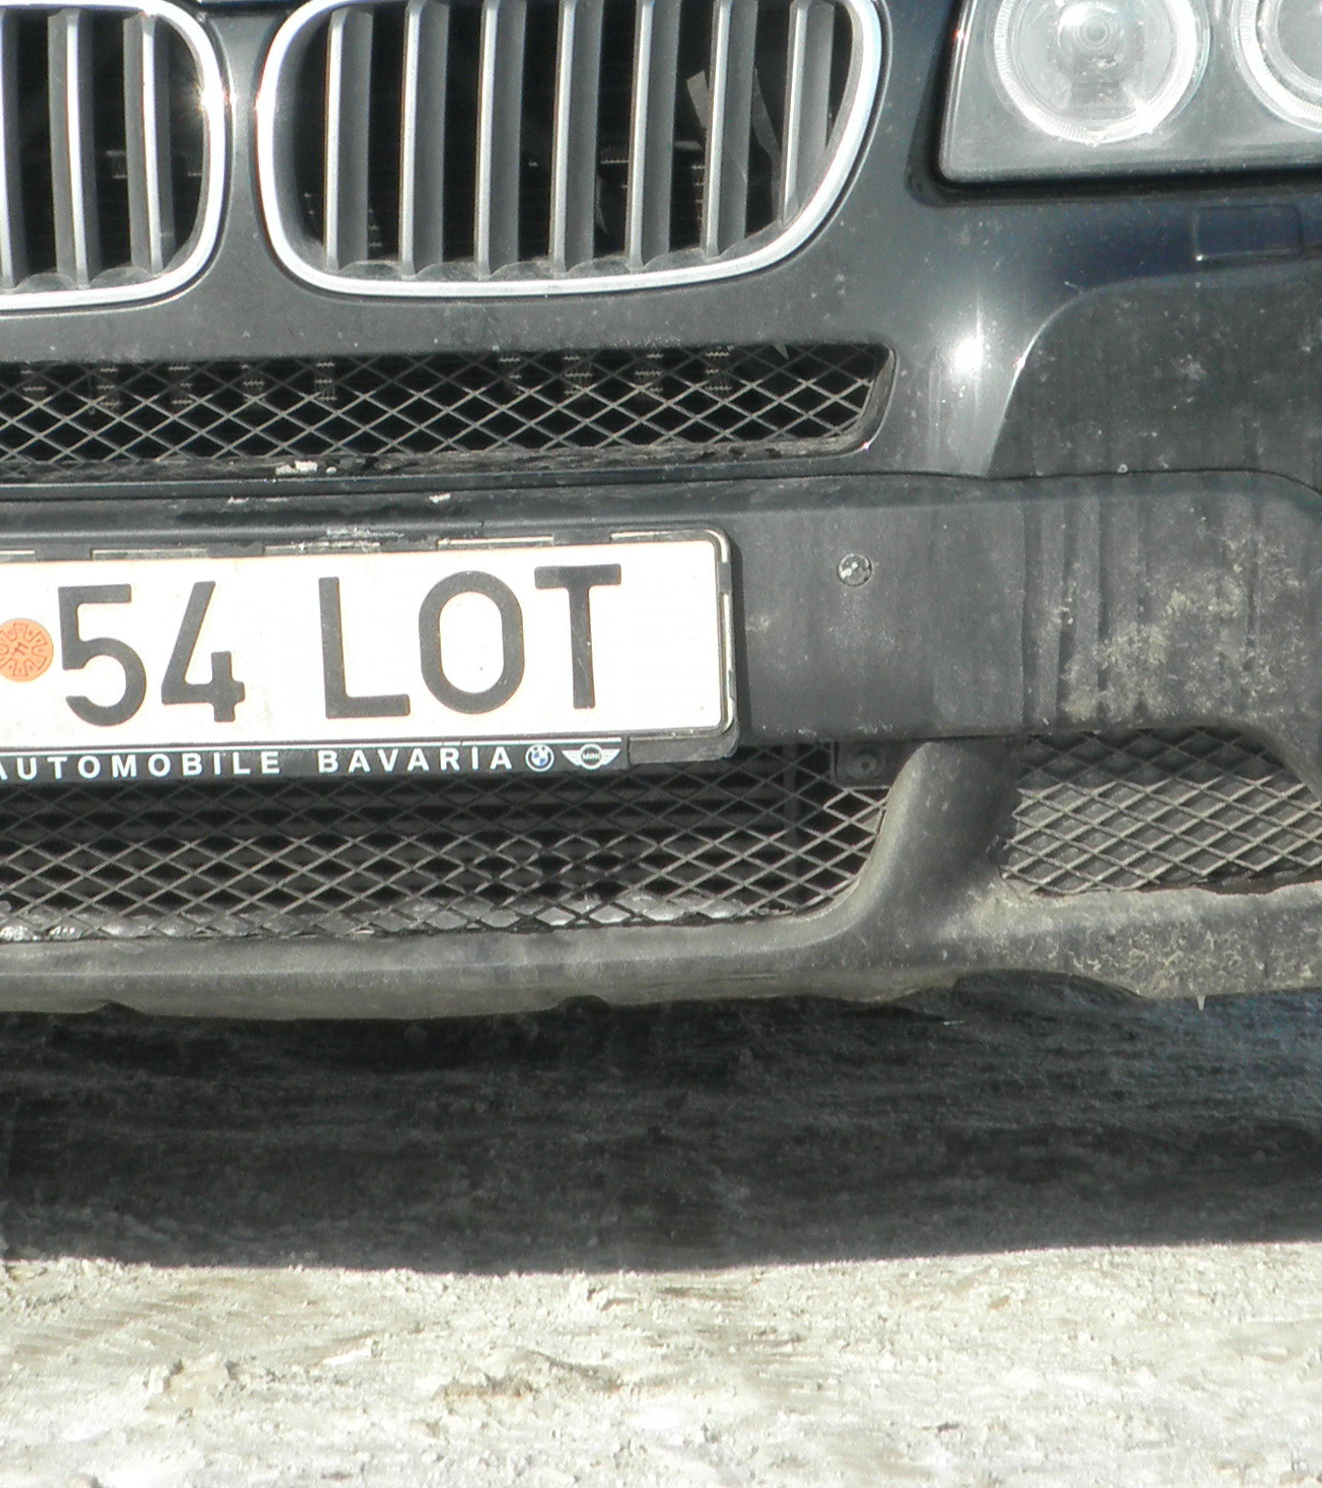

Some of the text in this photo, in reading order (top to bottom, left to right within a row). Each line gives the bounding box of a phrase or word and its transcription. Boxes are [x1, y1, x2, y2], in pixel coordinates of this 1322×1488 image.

[58, 581, 245, 727] 54
[318, 563, 621, 718] LOT
[317, 746, 512, 773] BAVARIA
